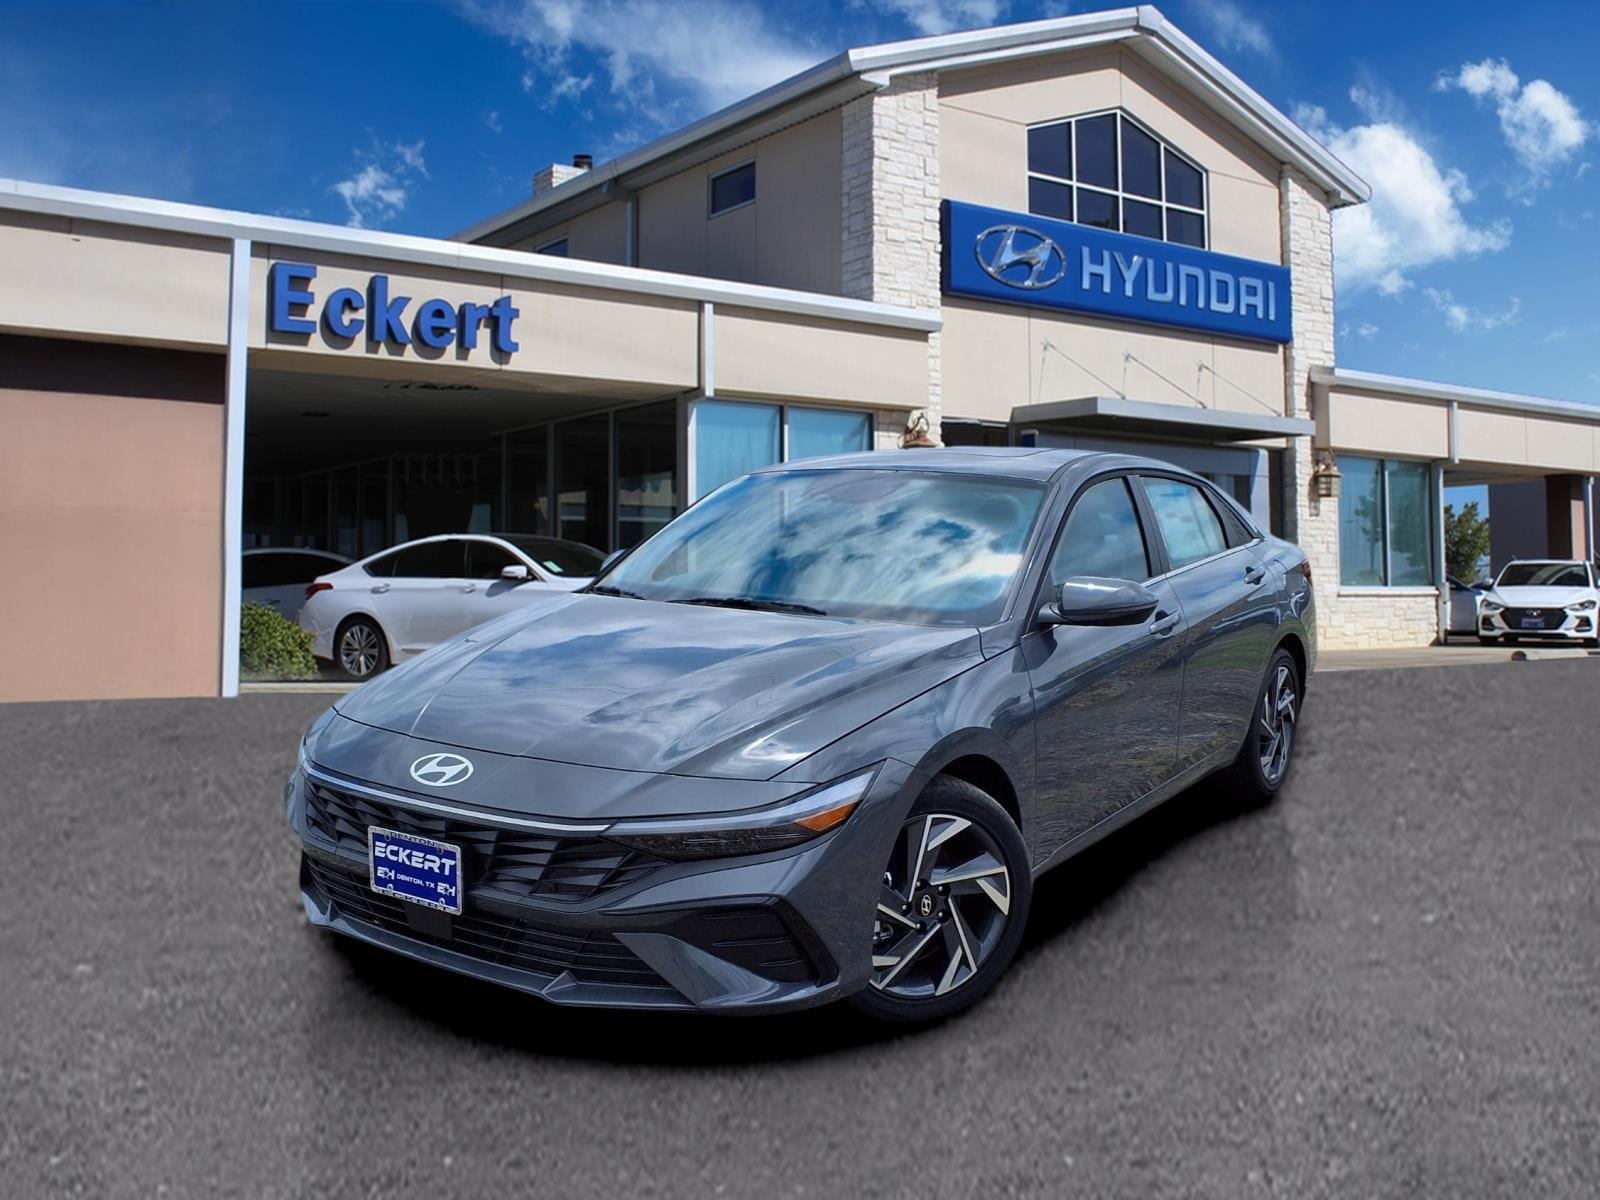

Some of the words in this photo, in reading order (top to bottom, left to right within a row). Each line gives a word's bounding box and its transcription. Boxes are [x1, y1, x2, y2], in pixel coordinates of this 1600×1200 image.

[1081, 246, 1276, 321] HYUNDAI
[270, 261, 519, 352] Eckert
[390, 831, 437, 847] DENTON
[374, 841, 457, 876] ECKERT
[396, 873, 425, 887] DENTON,
[425, 881, 436, 889] TX
